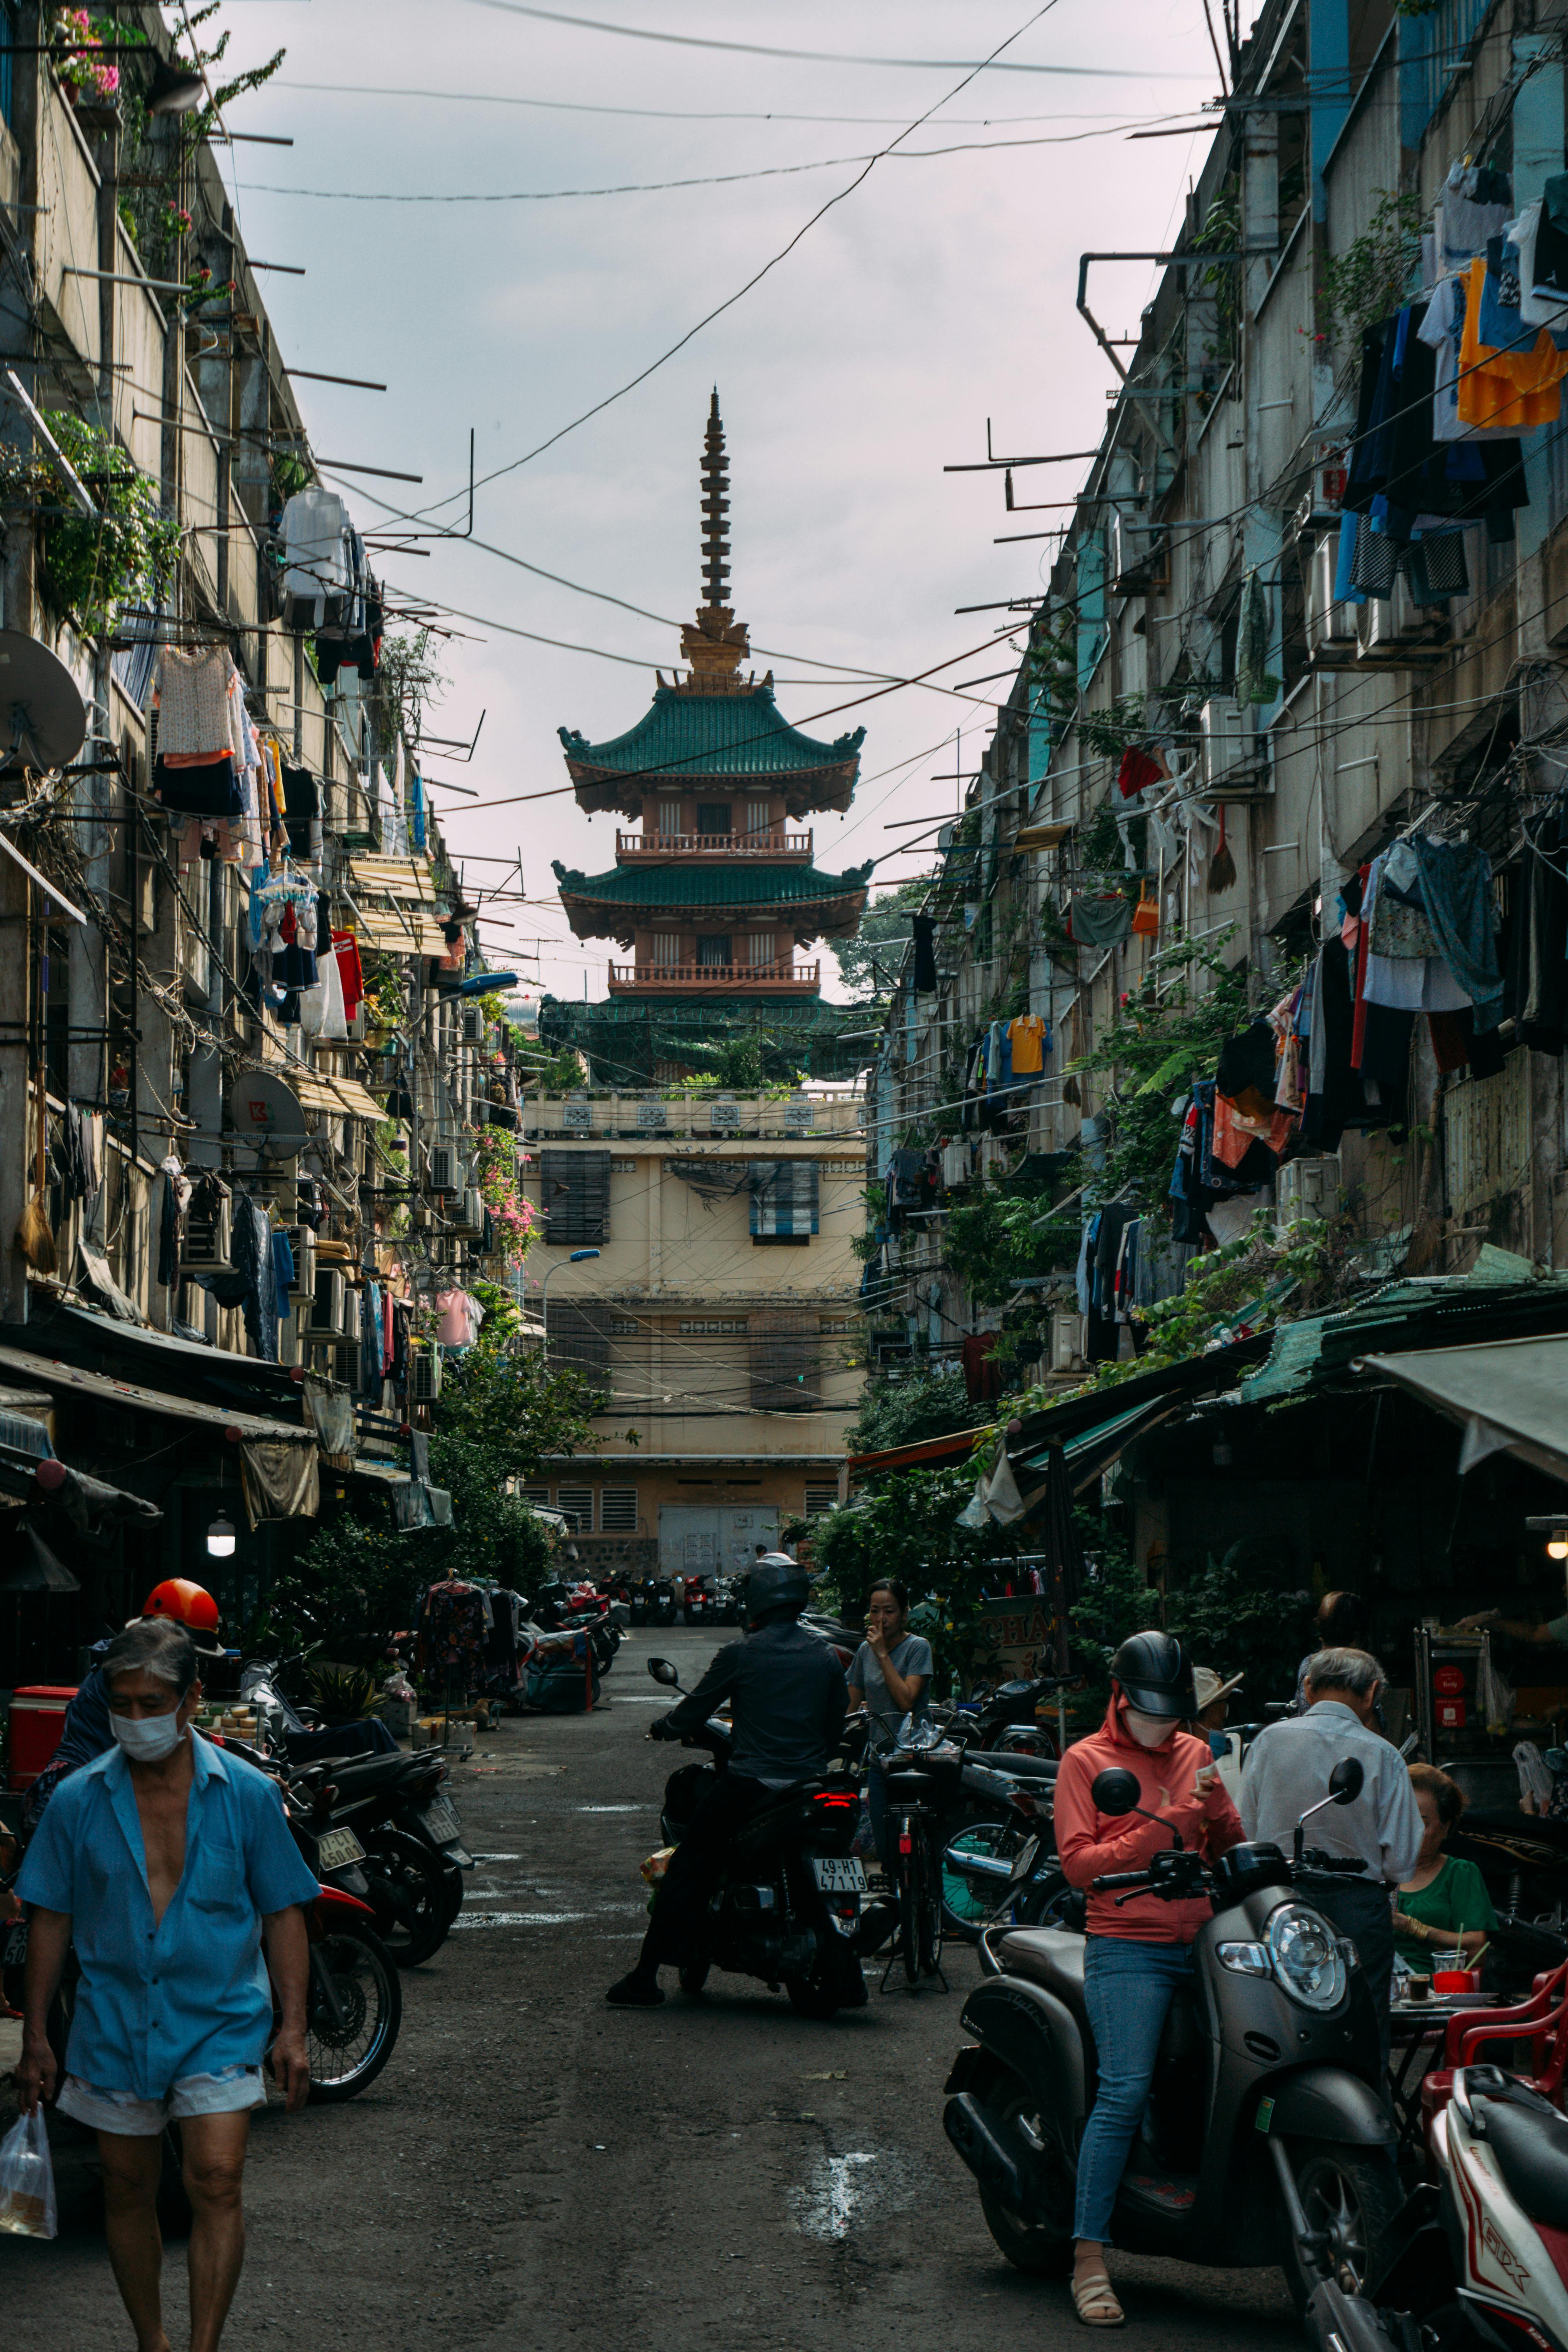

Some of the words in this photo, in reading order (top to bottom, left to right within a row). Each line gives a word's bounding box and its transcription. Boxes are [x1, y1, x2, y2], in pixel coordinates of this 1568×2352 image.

[432, 1823, 456, 1840] 0231
[822, 1860, 858, 1875] 49-H1
[820, 1875, 867, 1891] 471.19
